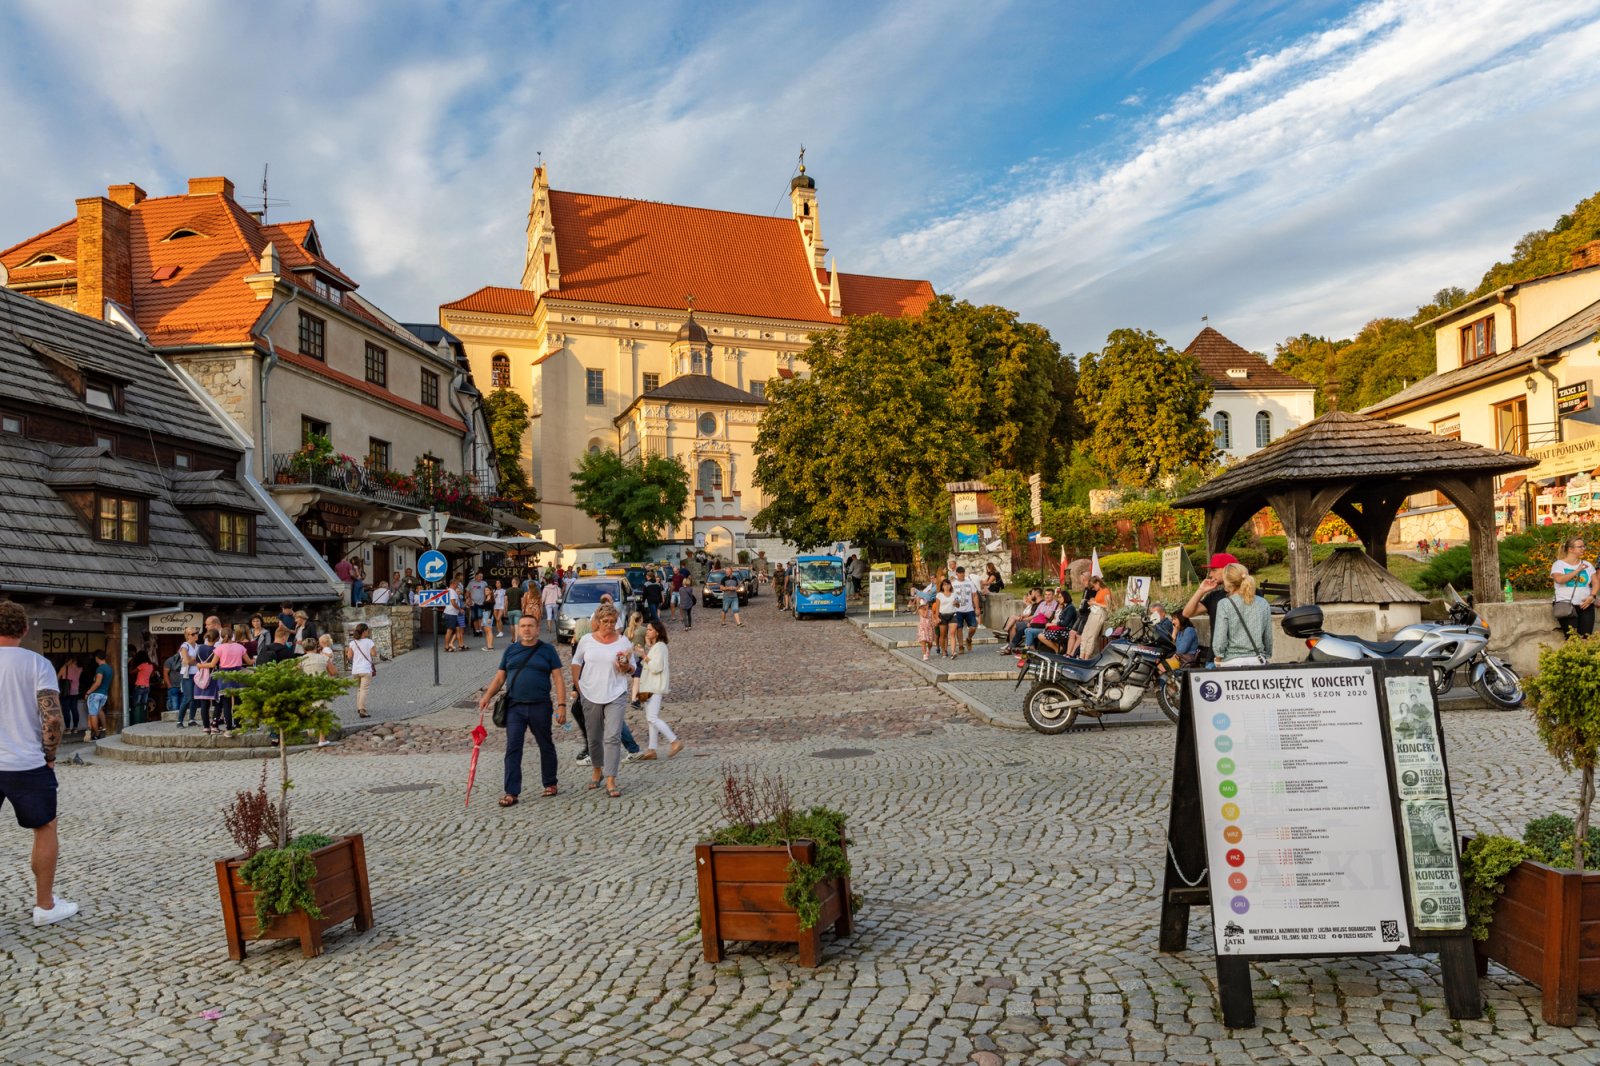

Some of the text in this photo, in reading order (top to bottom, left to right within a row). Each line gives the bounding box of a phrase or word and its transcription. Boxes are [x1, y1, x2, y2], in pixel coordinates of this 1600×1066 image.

[1559, 387, 1576, 396] TAXI
[1551, 439, 1596, 458] UPOMINKÓW
[490, 567, 524, 576] GOFRY
[420, 591, 449, 605] TAXI
[43, 633, 87, 651] Gofry
[1224, 675, 1365, 692] TRZECI KSIĘŻYC KONCERTY
[1396, 743, 1436, 754] KONCERT
[1415, 870, 1454, 880] KONCERT
[1438, 897, 1461, 905] TRZECI
[1225, 938, 1246, 946] JATKI
